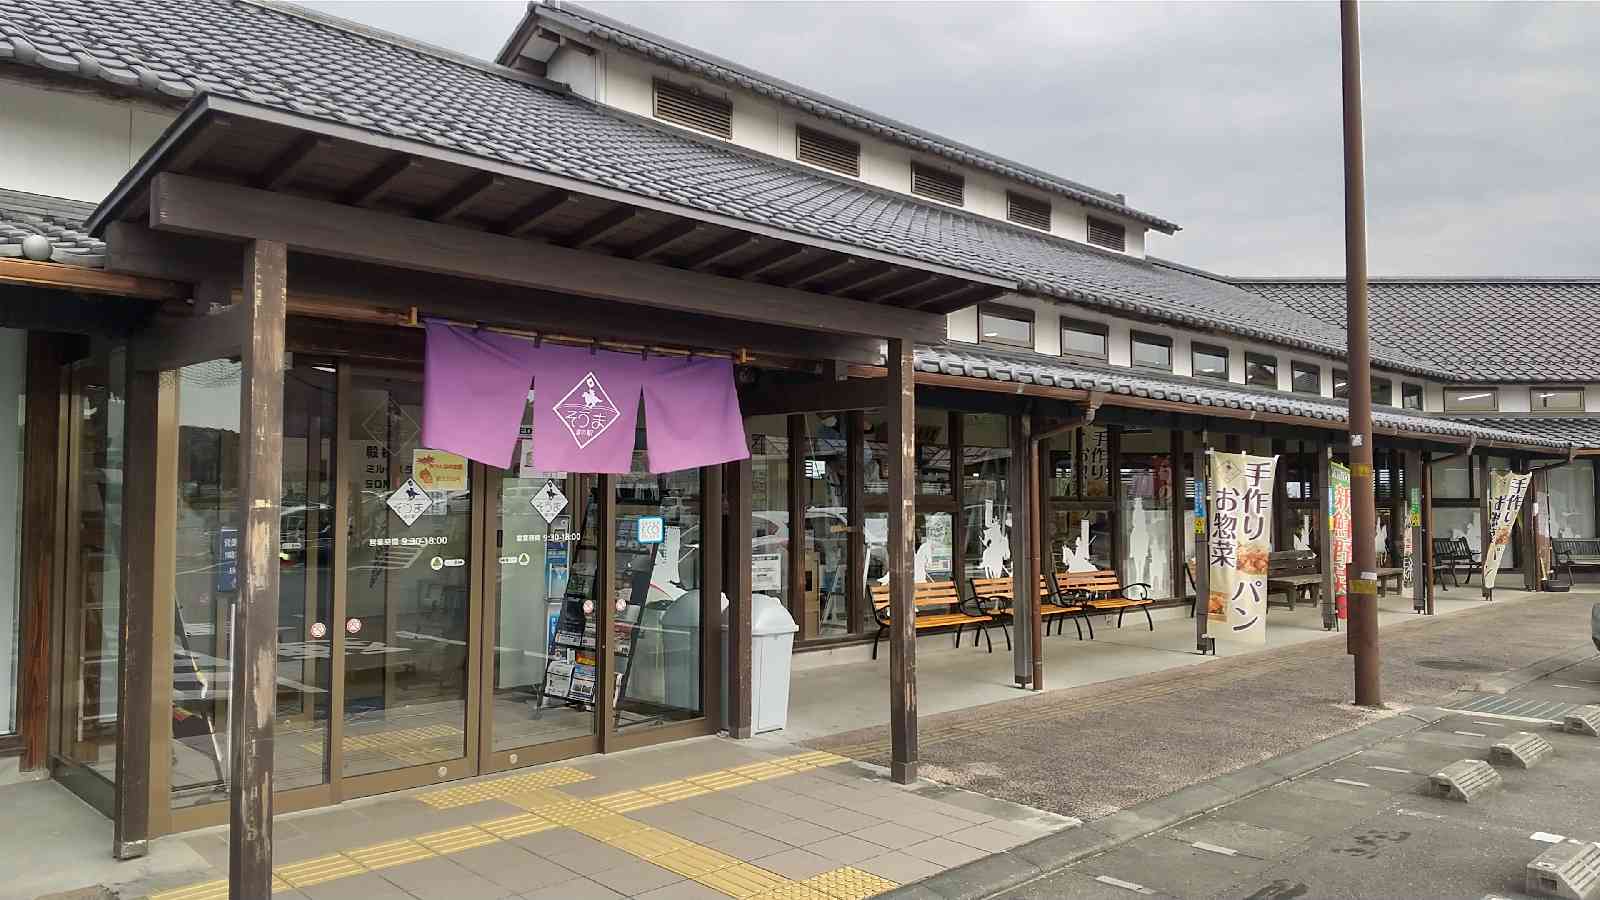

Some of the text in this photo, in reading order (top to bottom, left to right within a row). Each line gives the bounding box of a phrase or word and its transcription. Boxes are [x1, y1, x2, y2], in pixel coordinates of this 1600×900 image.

[565, 410, 608, 430] そうま
[1210, 487, 1240, 569] お惣菜
[1242, 462, 1271, 541] 手作り
[1231, 581, 1263, 632] パン
